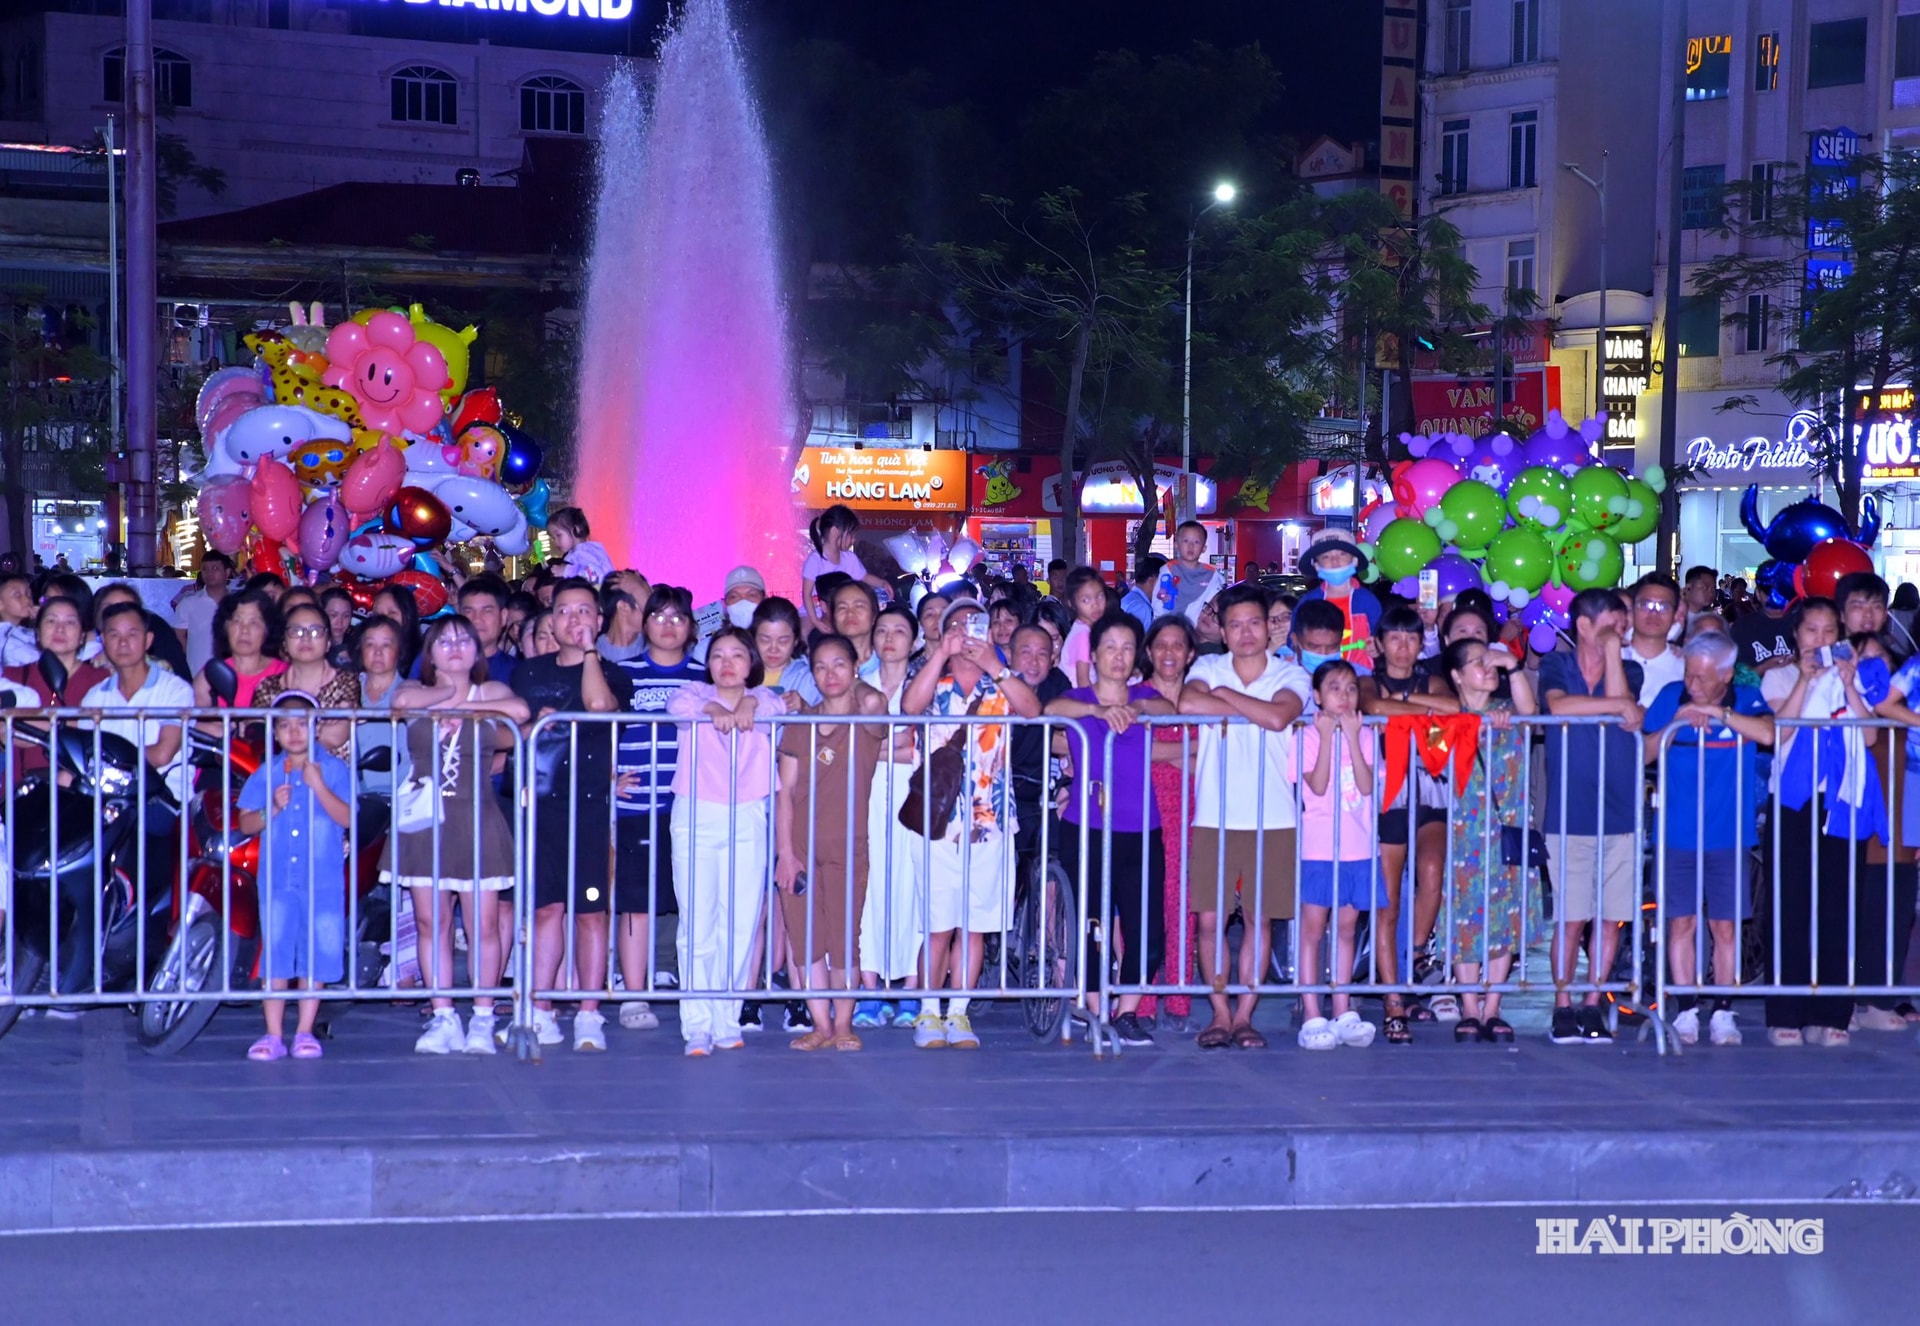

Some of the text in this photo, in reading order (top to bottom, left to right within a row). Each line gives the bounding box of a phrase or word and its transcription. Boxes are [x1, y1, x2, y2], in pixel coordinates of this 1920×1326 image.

[402, 0, 633, 20] MOND
[1605, 336, 1643, 359] VÀNG
[1608, 412, 1637, 438] BẢO
[848, 452, 873, 465] hoa
[1687, 436, 1812, 471] Photo Palette
[826, 476, 931, 500] HỒNG LAM
